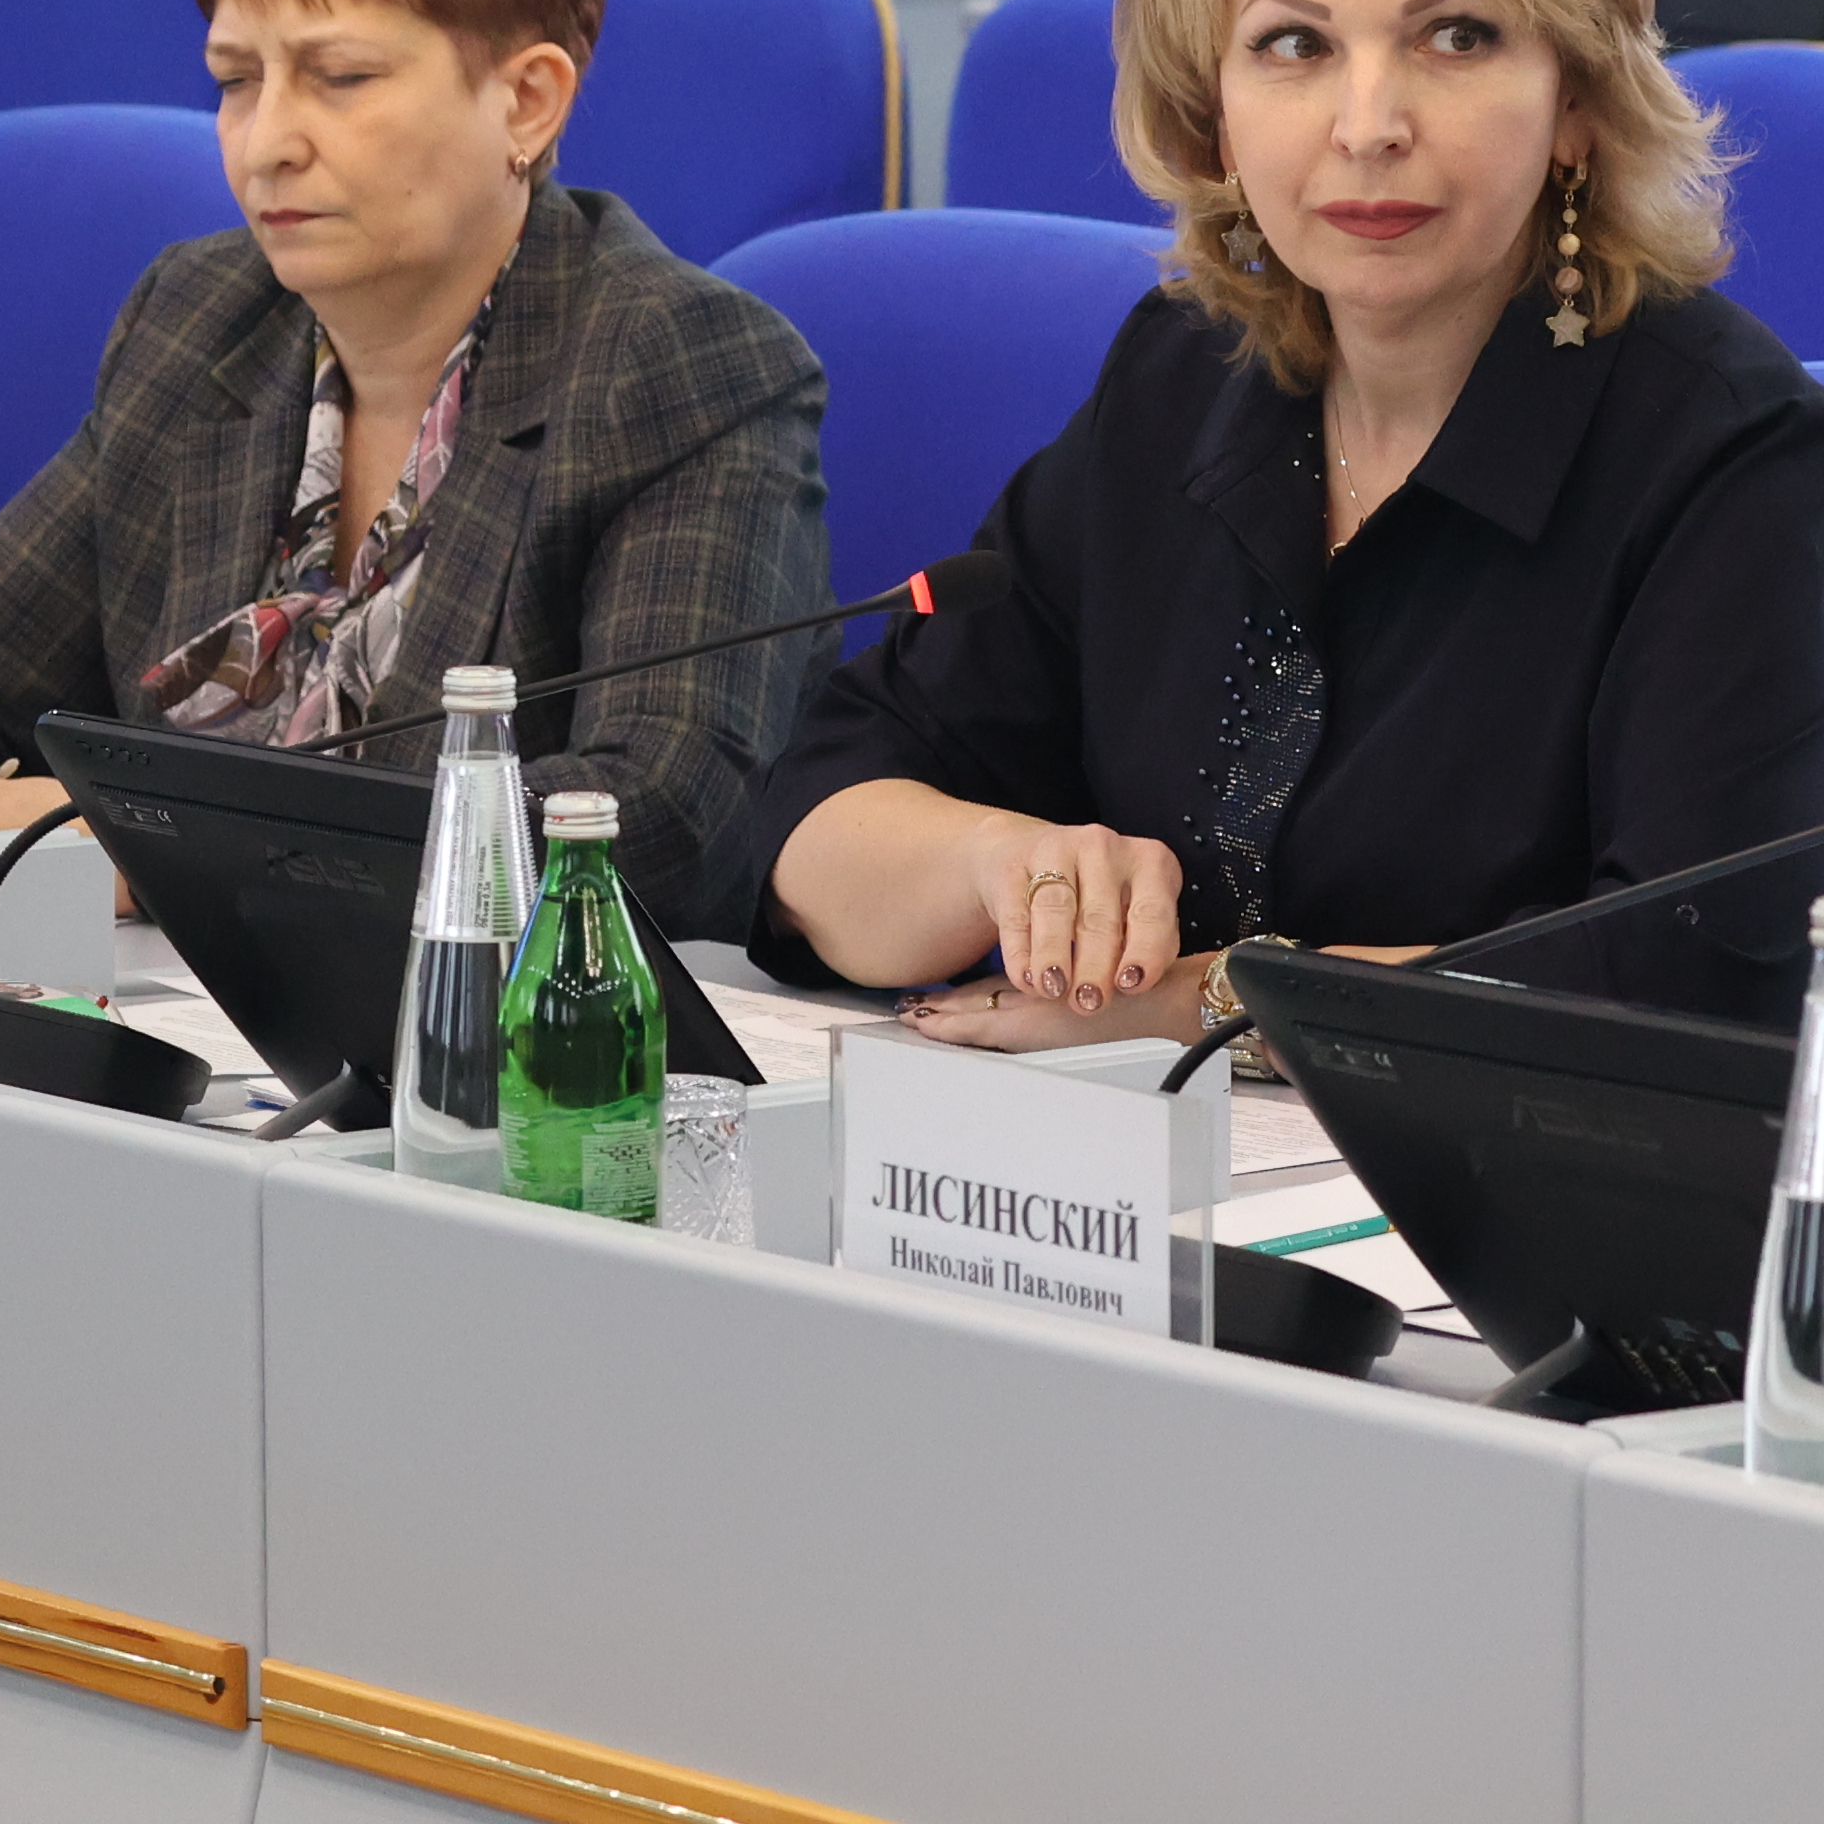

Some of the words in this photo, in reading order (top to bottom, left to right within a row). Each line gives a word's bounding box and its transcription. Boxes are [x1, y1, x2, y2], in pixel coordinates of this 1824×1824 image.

[871, 1162, 1139, 1263] ЛИСИНСКИЙ
[890, 1235, 995, 1290] Николай
[1003, 1259, 1123, 1317] Павлович
